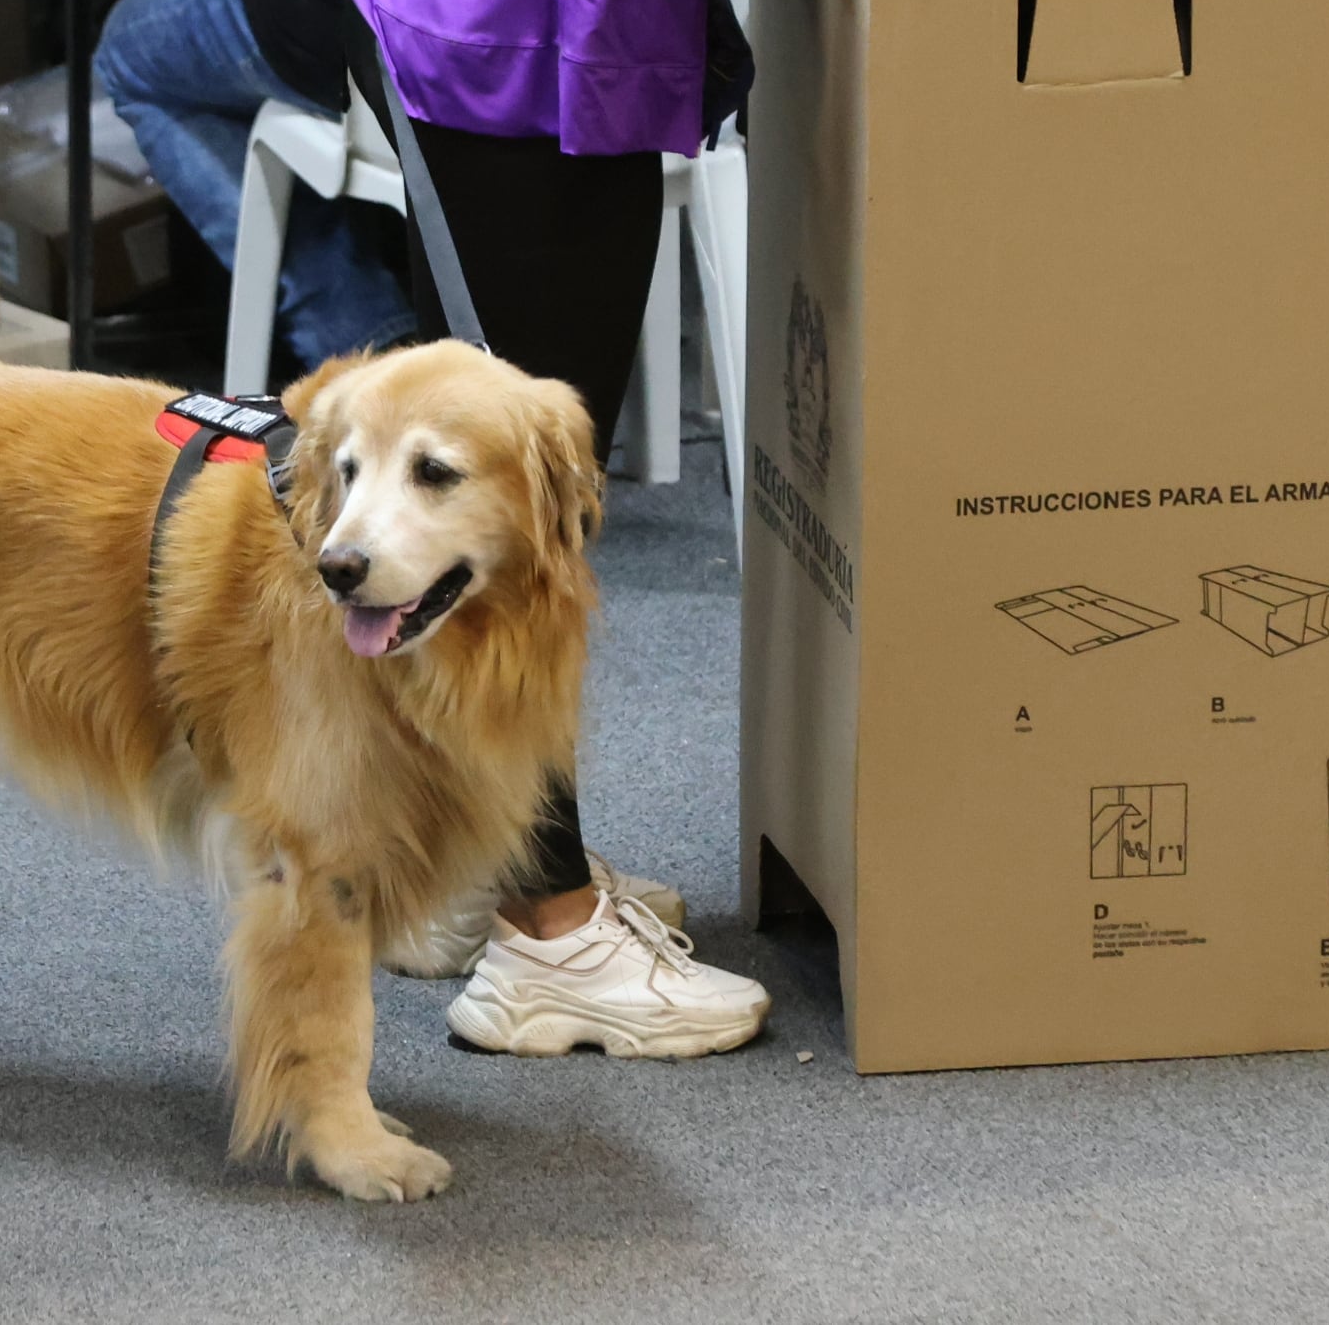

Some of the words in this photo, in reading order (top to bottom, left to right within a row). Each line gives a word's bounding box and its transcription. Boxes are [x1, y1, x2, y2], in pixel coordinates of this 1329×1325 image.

[955, 487, 1152, 517] INSTRUCCIONES
[1158, 485, 1224, 507] PARA
[1229, 483, 1260, 505] EL
[1211, 696, 1225, 713] B
[1015, 705, 1031, 722] A
[1094, 903, 1109, 921] D
